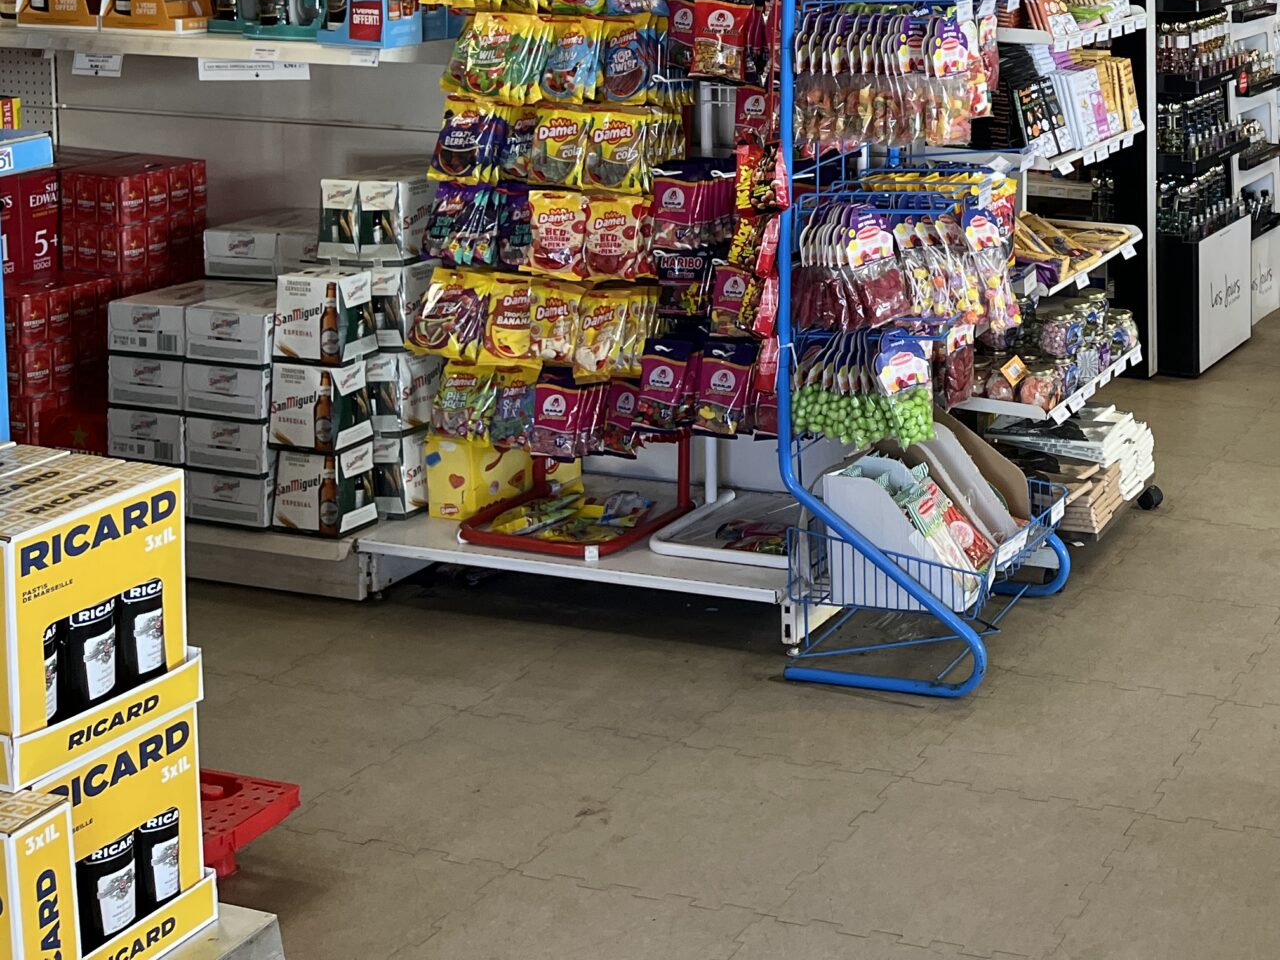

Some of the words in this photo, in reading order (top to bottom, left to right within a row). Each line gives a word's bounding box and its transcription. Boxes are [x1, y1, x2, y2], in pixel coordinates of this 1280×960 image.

[358, 7, 379, 15] VERRE
[353, 14, 380, 26] OFFERT!
[612, 49, 631, 63] TOP
[539, 124, 578, 140] Damel
[594, 124, 632, 142] Damel
[539, 211, 575, 224] Damel
[661, 256, 703, 270] HARIBO
[536, 304, 568, 320] Damel
[283, 328, 313, 338] ESPECIAL
[278, 415, 308, 426] ESPECIAL
[26, 479, 118, 515] RICARD
[20, 490, 177, 577] RICARD
[144, 527, 177, 552] 3x1L
[22, 582, 49, 597] PASTIS
[22, 594, 33, 604] DE
[33, 578, 74, 601] MARSEILLE
[78, 598, 116, 623] RICAR
[67, 694, 160, 751] RICARD
[160, 755, 191, 783] 3x1L
[25, 823, 60, 856] 3x1L
